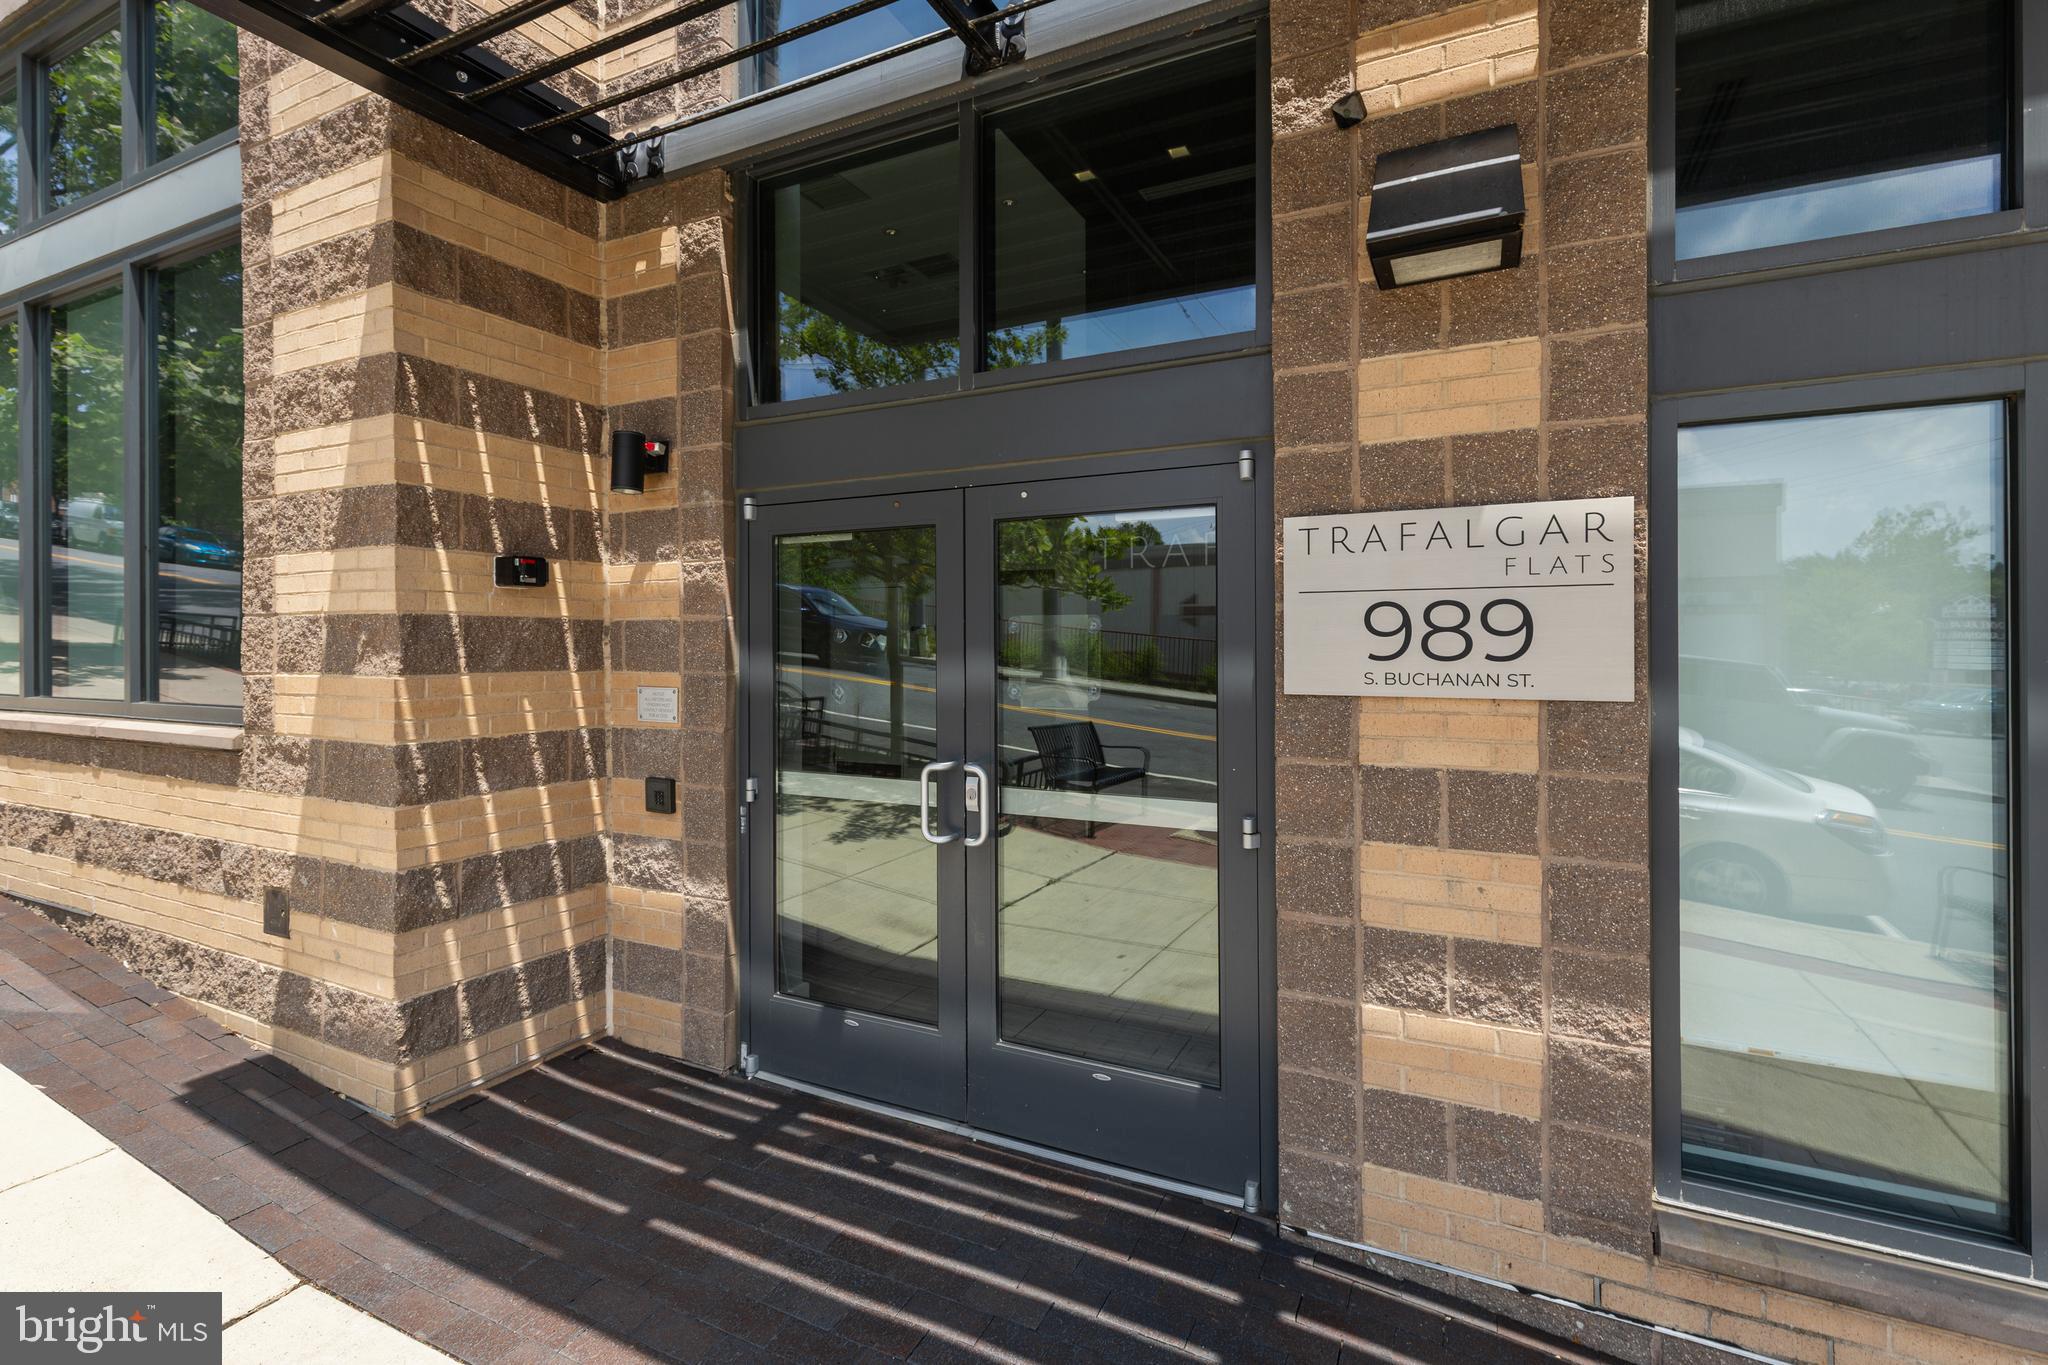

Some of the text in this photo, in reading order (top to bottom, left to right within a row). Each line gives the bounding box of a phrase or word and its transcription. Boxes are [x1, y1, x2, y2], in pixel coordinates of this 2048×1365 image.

[1298, 511, 1614, 555] TRAFALGAR
[1504, 553, 1615, 576] FLATS
[1364, 598, 1534, 662] 989
[1364, 671, 1535, 688] S. BUCHANAN ST.
